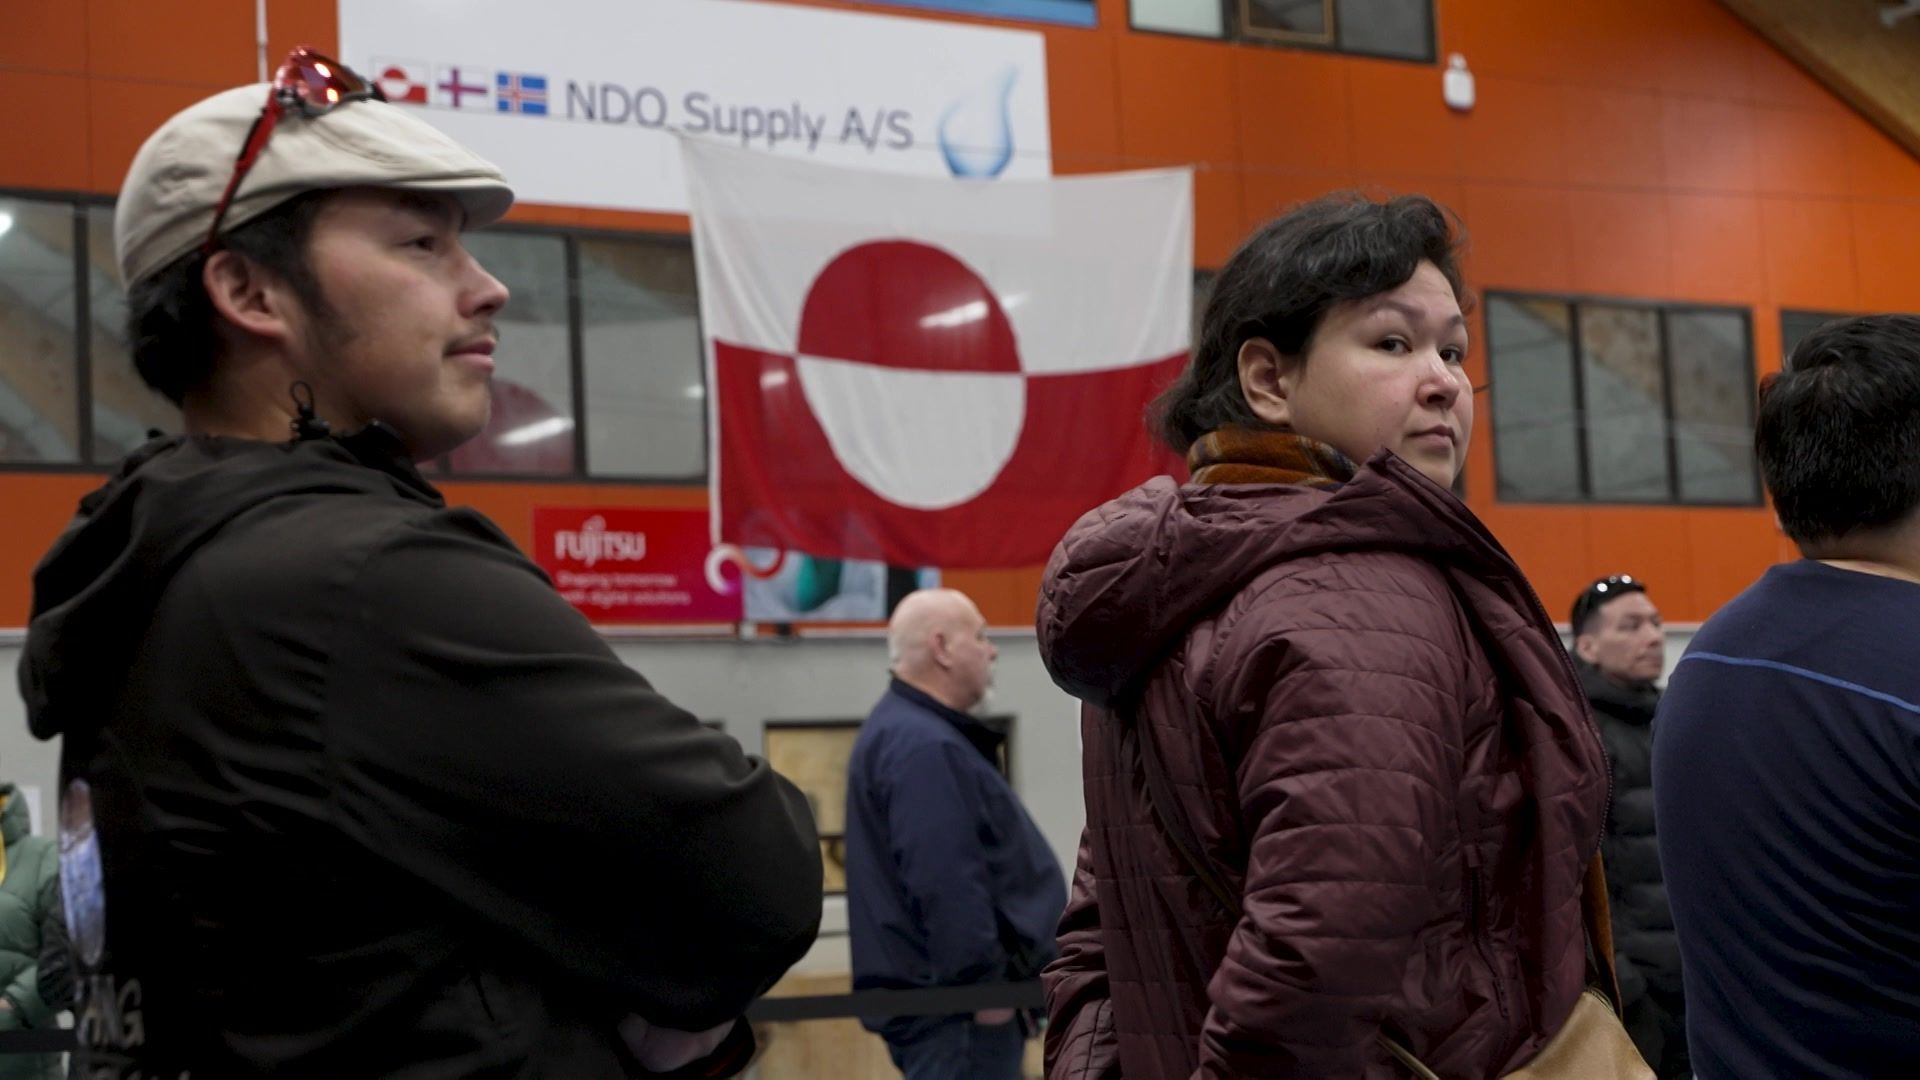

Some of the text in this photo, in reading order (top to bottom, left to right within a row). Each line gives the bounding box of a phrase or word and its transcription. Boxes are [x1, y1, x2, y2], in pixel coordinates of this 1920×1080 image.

[565, 80, 915, 153] NDO Supply A/S
[554, 516, 647, 568] FUJITSU
